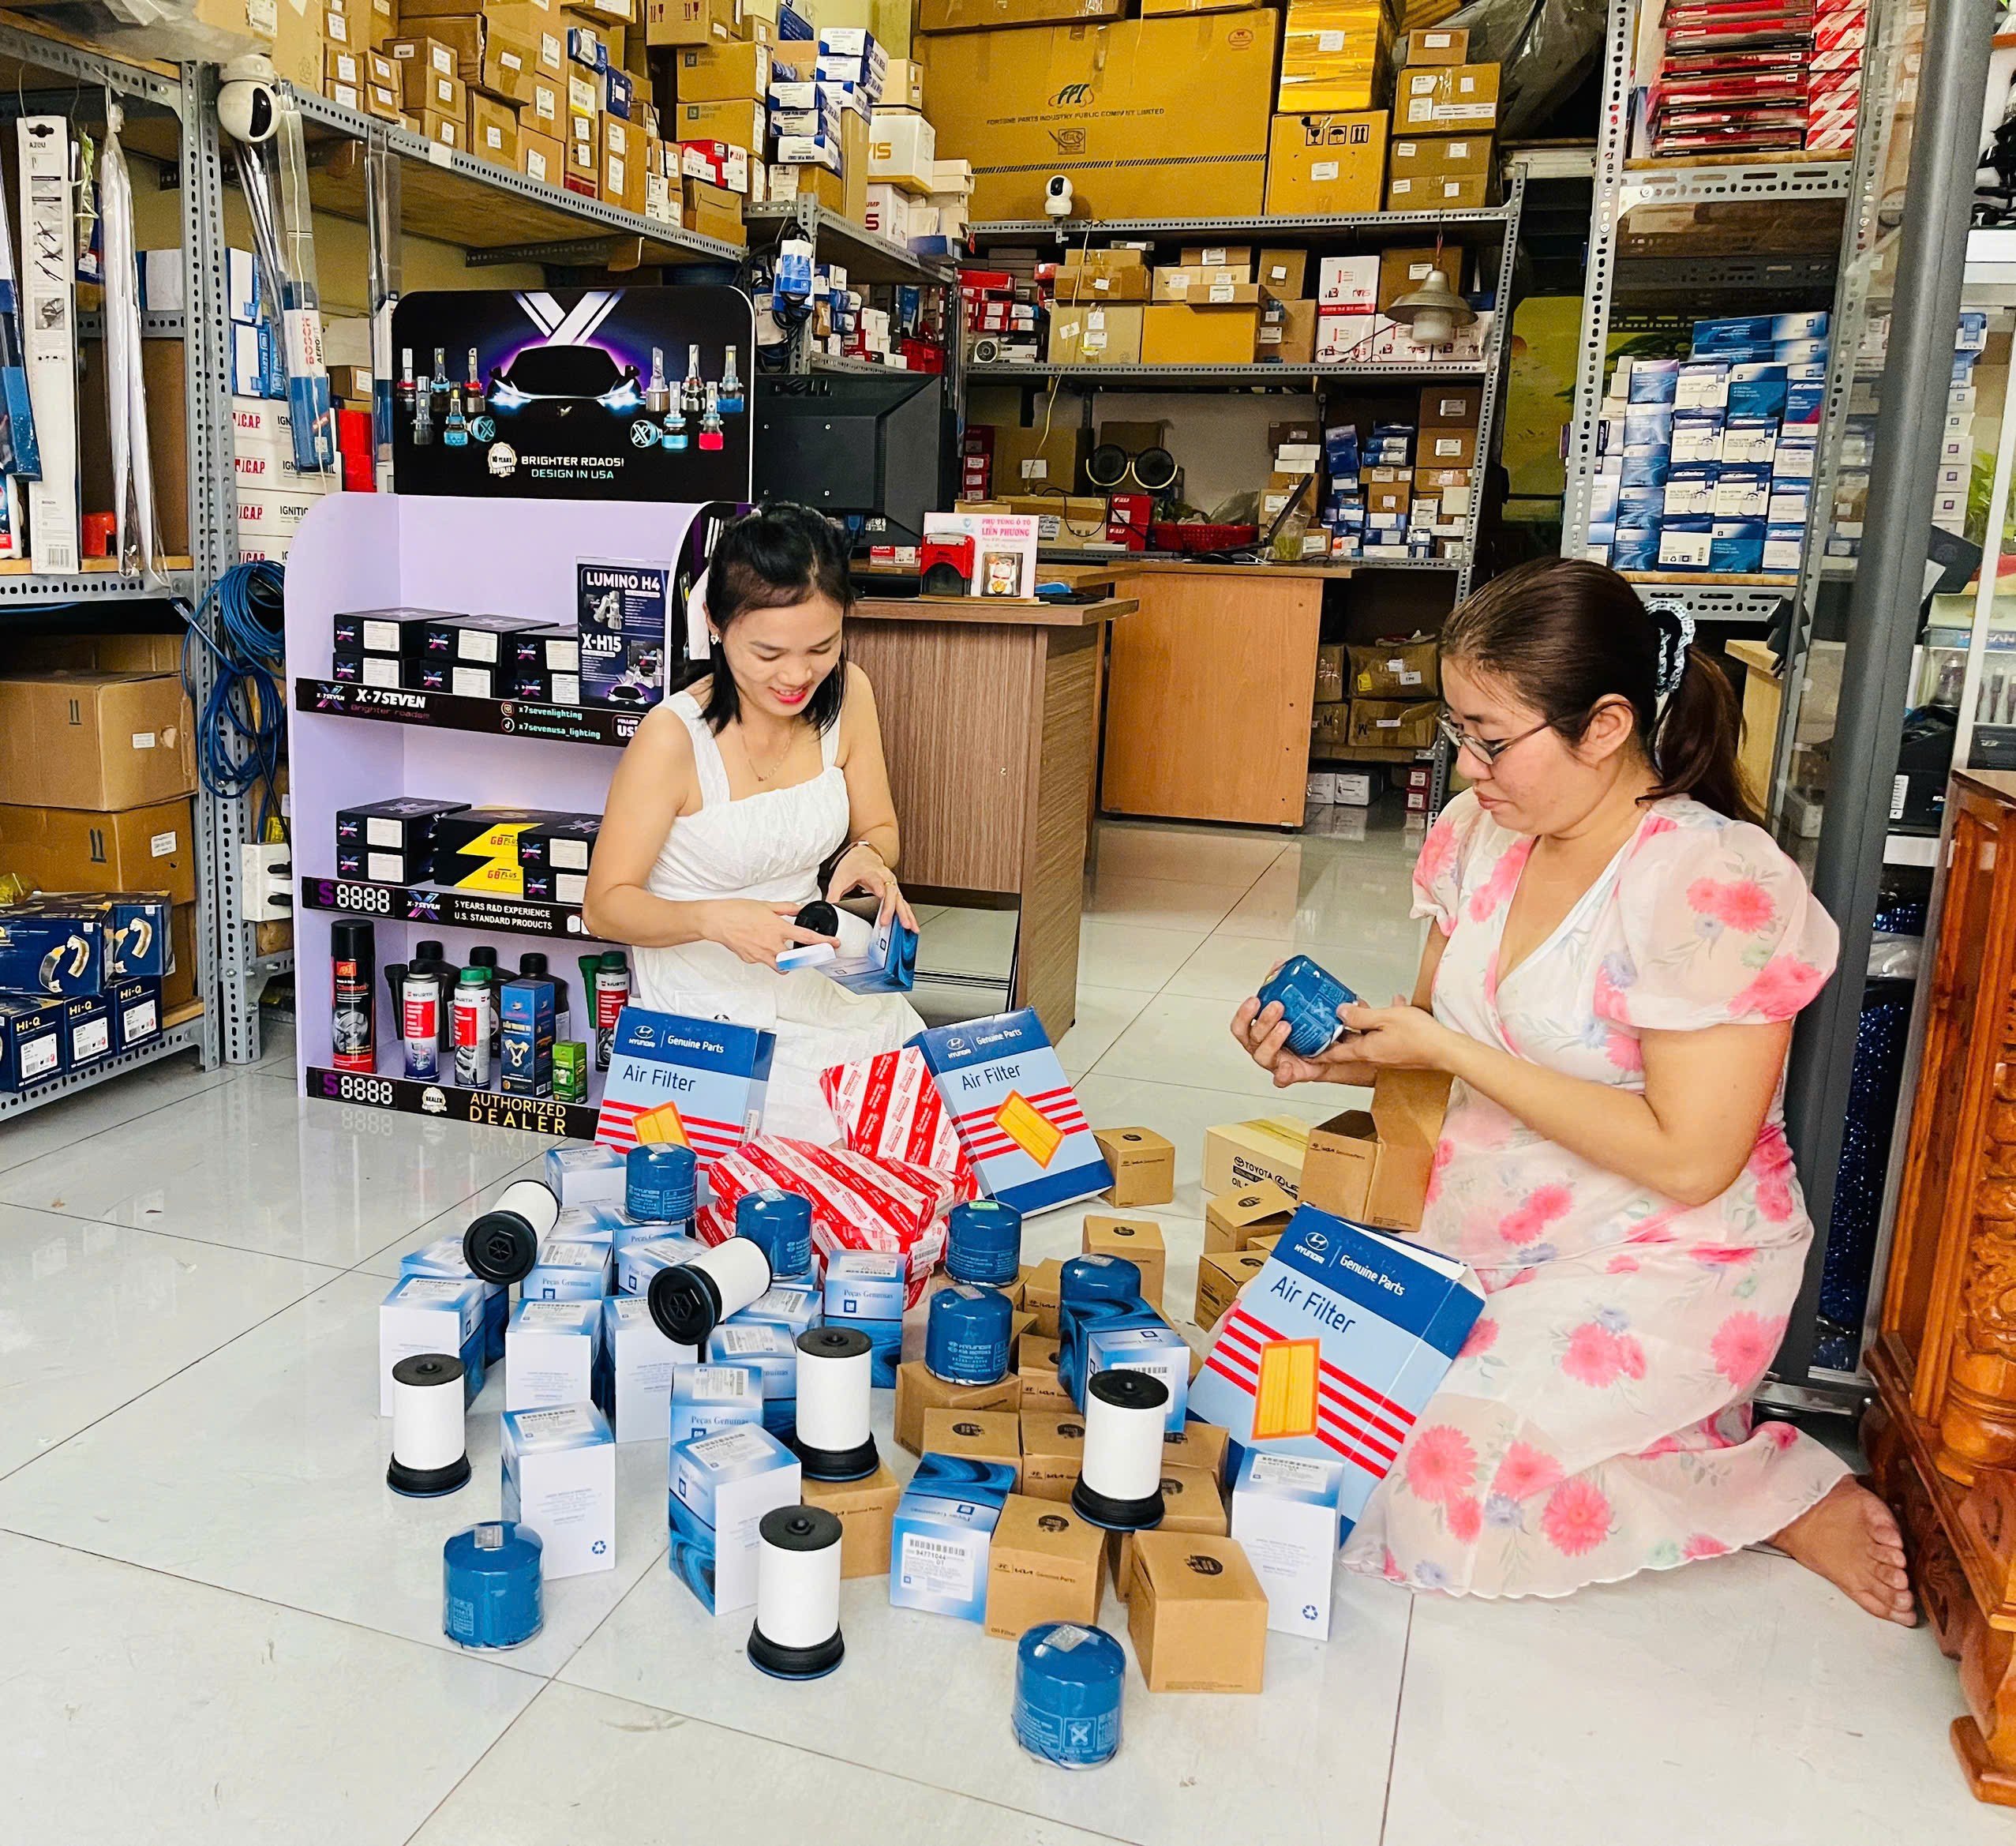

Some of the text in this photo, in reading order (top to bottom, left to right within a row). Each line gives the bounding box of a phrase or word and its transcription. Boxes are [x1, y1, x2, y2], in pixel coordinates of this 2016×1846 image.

[521, 456, 624, 467] BRIGHTER ROADS!
[531, 468, 614, 479] DESIGN IN USA
[586, 572, 661, 591] LUMINO H4
[581, 632, 622, 652] X-H15
[350, 704, 391, 715] Brighter
[519, 705, 583, 721] x7sevenlighting
[519, 722, 601, 740] x7sevenusa_lighting
[455, 899, 551, 918] 5 YEARS R&D EXPERIENCE
[455, 912, 553, 930] U.S. STANDARD PRODUCTS
[120, 985, 143, 1000] Hi-Q
[69, 1000, 92, 1017] Hi-Q
[16, 1017, 40, 1033] Hi-Q
[628, 1037, 656, 1049] HYUNDAI
[667, 1034, 725, 1054] Genuine Parts
[976, 1028, 1023, 1046] Genuine Parts
[947, 1048, 972, 1060] HYUNDAI
[623, 1064, 696, 1093] Air Filter
[961, 1064, 1021, 1091] Air Filter
[470, 1093, 567, 1117] AUTHORIZED
[469, 1108, 567, 1135] DEALER
[1244, 1161, 1272, 1180] TOYOTA
[1232, 1177, 1243, 1188] OIL
[1295, 1243, 1325, 1265] HYUNDAI
[1340, 1254, 1406, 1296] Genuine Parts
[1269, 1275, 1357, 1334] Air Filter
[916, 1549, 947, 1561] 94771044
[1014, 1567, 1034, 1576] KIA
